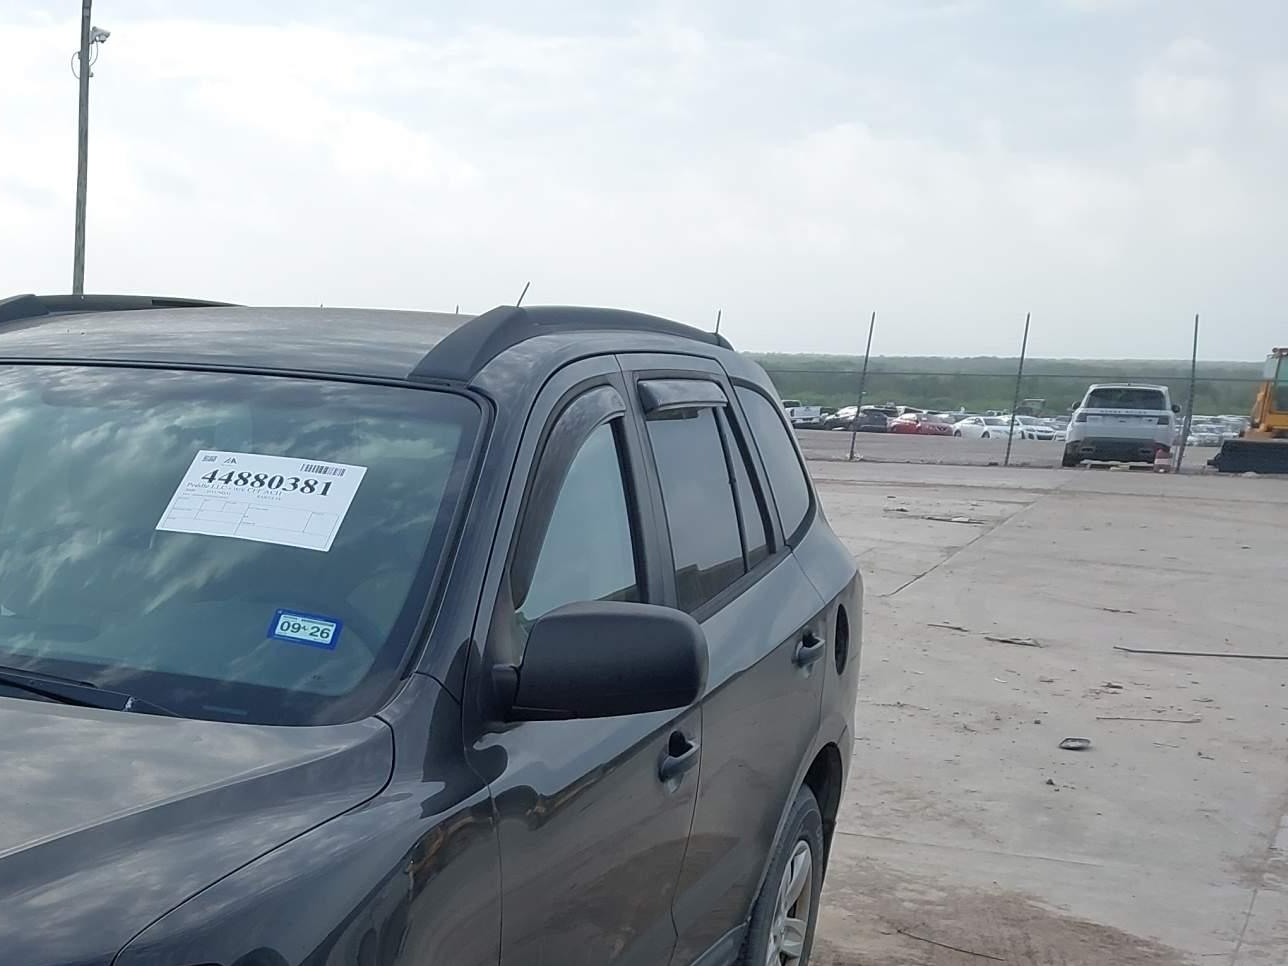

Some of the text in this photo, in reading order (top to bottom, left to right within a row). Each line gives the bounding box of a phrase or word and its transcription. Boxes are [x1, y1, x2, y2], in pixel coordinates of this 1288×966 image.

[201, 469, 332, 496] 44880381
[279, 620, 301, 634] 09
[309, 625, 332, 639] 26
